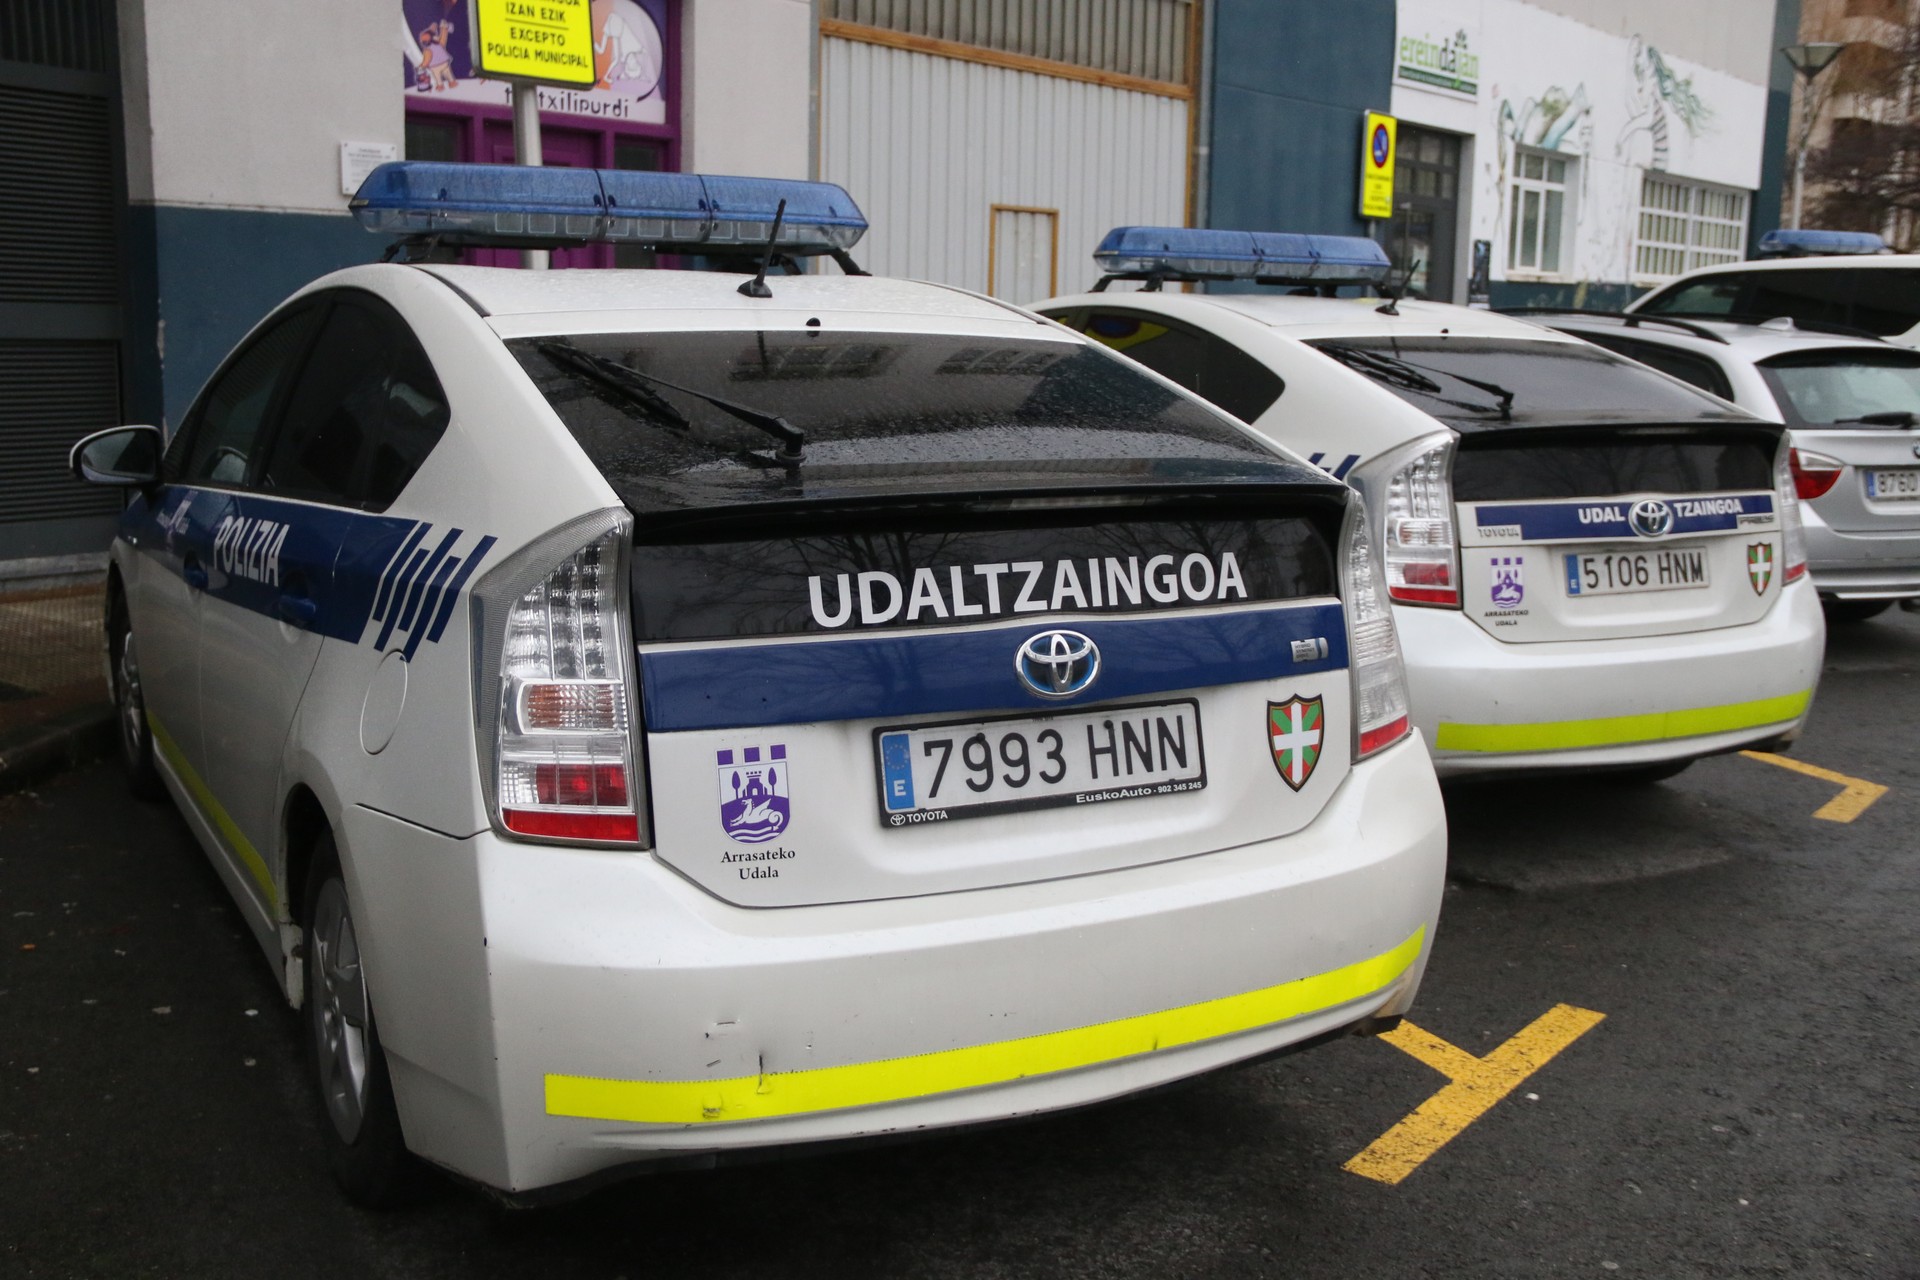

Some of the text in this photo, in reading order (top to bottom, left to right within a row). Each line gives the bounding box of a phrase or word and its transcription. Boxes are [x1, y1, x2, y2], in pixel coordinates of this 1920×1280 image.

[506, 2, 566, 23] IZAN EZIK
[510, 27, 566, 47] EXCEPTO
[487, 42, 588, 68] POLICIA MUNICIPAL
[1578, 499, 1744, 524] UDAL TZAINGOA
[213, 515, 290, 587] POLIZIA
[1583, 555, 1649, 589] 5106
[1657, 552, 1704, 585] HNM
[808, 551, 1248, 628] UDALTZAINGOA
[1484, 609, 1529, 617] ARRASATEKO
[893, 715, 1188, 799] E 7993 HNN
[1075, 781, 1202, 804] EuskoAuto 902 345 245
[907, 810, 949, 823] TOYOTA
[720, 847, 796, 863] Arrasateko
[739, 866, 779, 880] Udala
